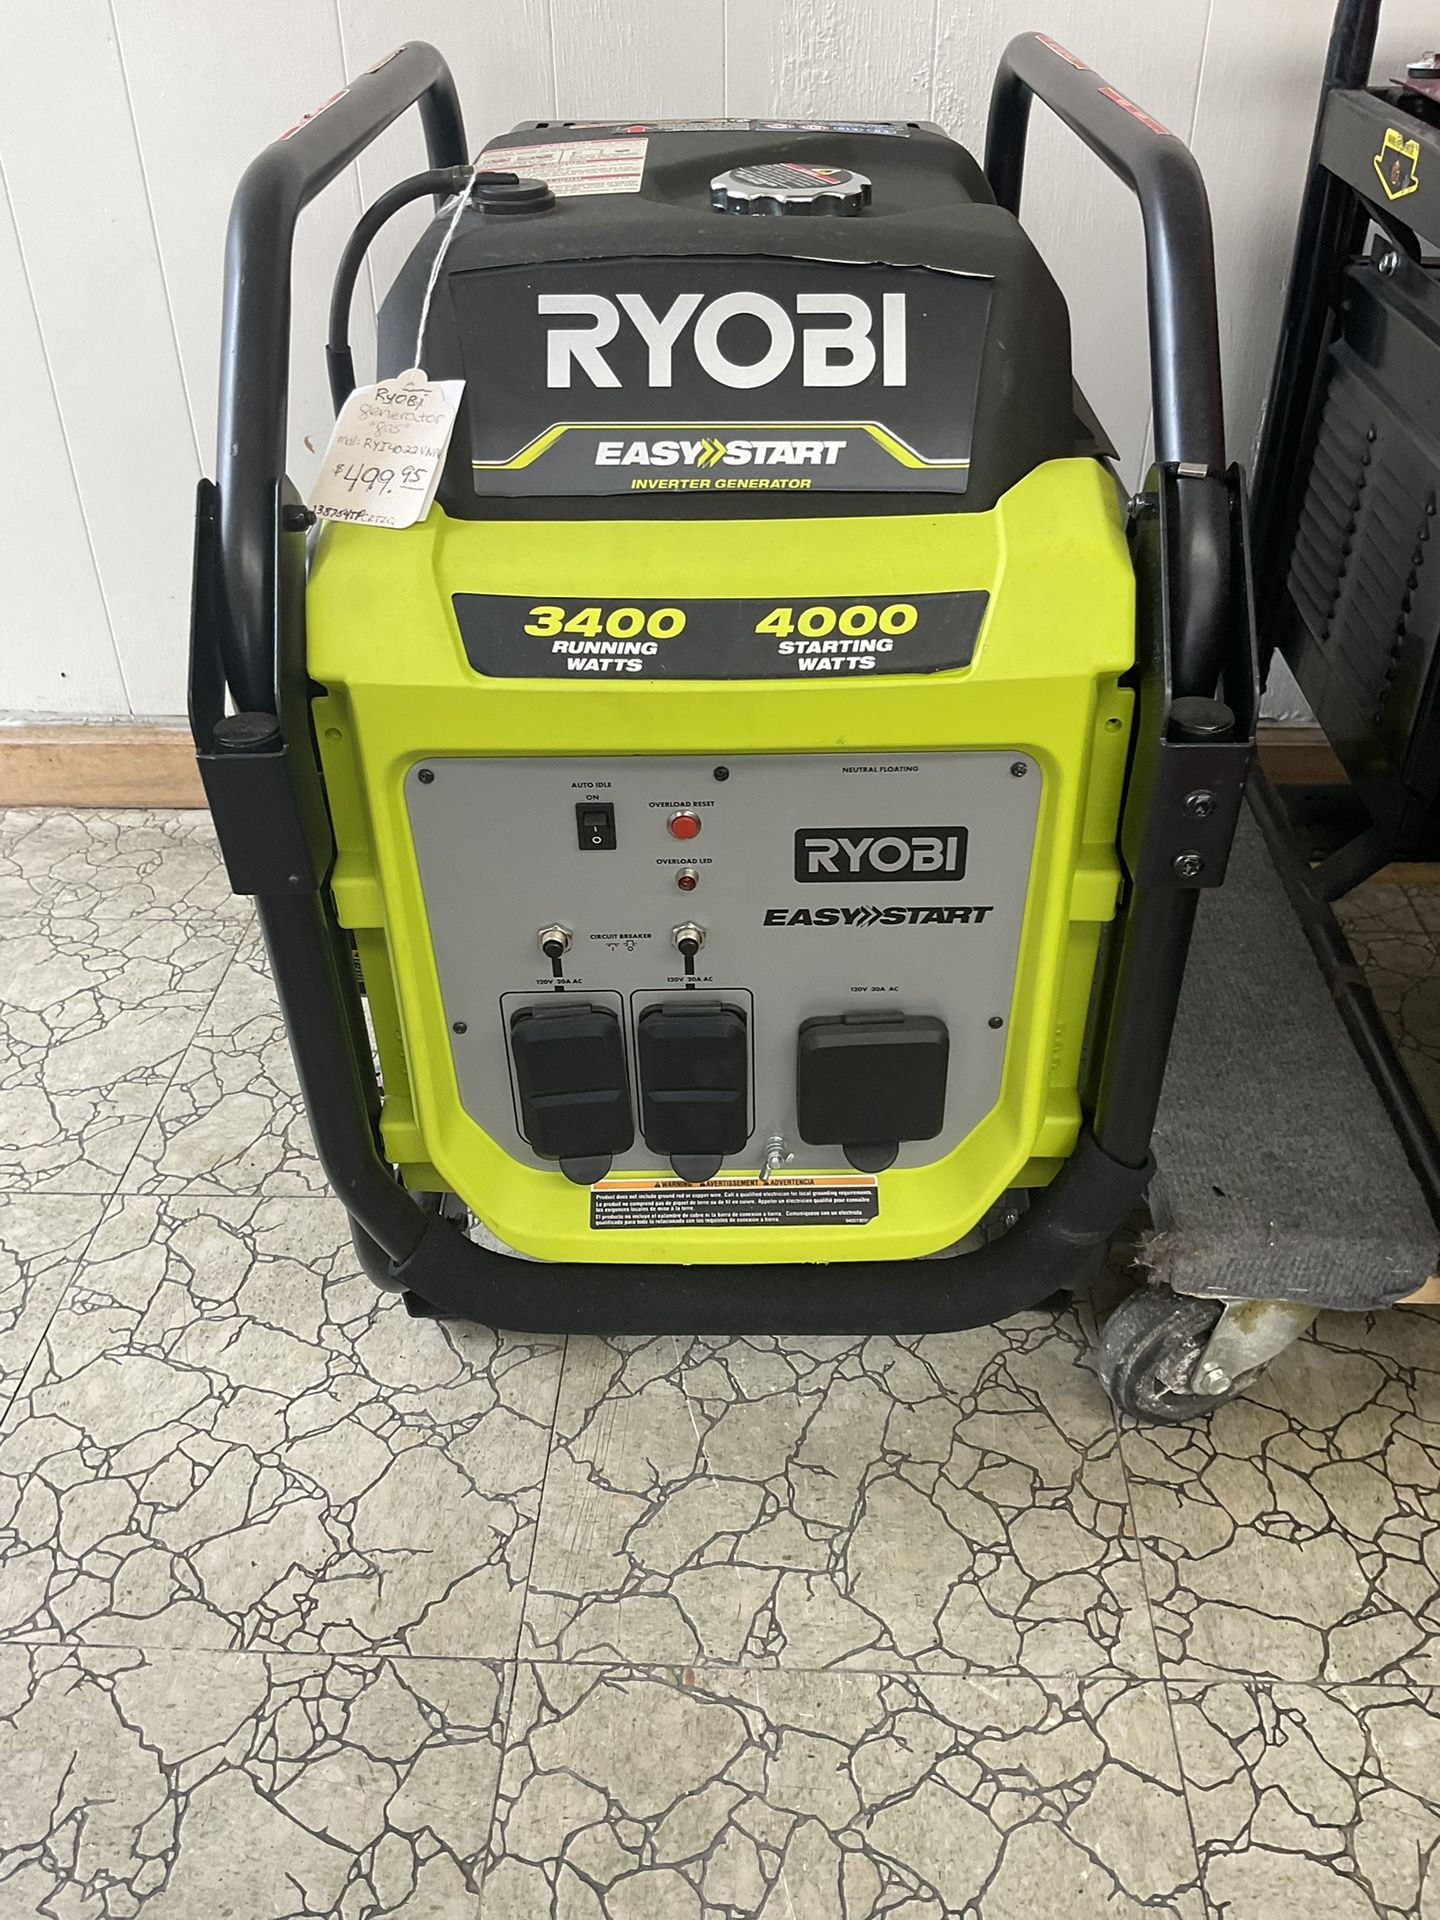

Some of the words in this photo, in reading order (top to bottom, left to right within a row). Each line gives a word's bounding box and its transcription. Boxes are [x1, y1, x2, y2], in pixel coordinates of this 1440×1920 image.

[537, 291, 906, 389] RYOBI
[594, 440, 703, 466] EASY
[722, 440, 846, 466] START
[630, 478, 711, 489] INVERTER
[714, 477, 812, 489] GENERATOR
[522, 605, 687, 639] 3400
[753, 603, 919, 638] 4000
[551, 639, 659, 656] RUNNING
[777, 637, 894, 655] STARTING
[566, 656, 644, 673] WATTS
[797, 655, 877, 671] WATTS
[879, 765, 919, 773] FLOATING
[804, 836, 958, 873] RYOBI
[763, 906, 861, 926] EASY
[879, 905, 994, 925] START
[706, 1179, 758, 1187] AVERTISSEMENT
[770, 1178, 815, 1186] ADVERTENCIA
